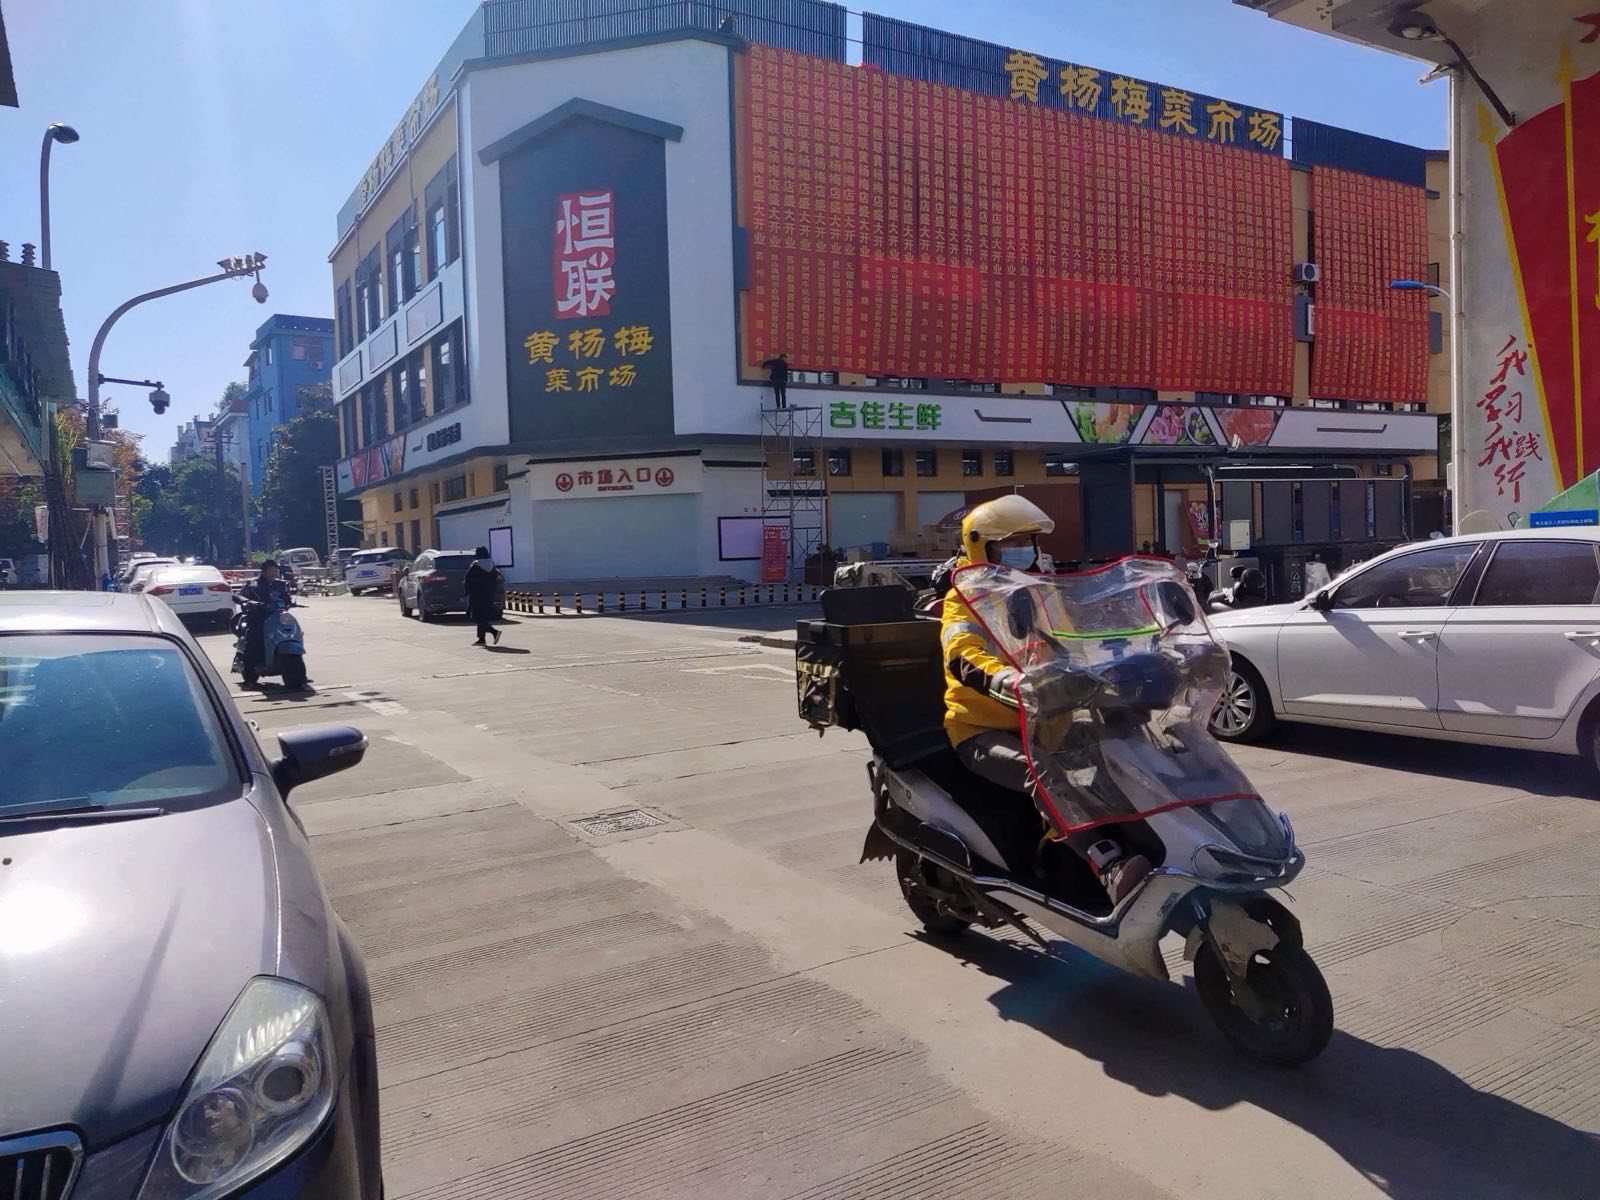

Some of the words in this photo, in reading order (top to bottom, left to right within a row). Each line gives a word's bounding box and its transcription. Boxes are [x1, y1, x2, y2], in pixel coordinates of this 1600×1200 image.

[1004, 50, 1283, 150] 黄杨梅菜市场
[556, 192, 615, 316] 恒联
[524, 325, 655, 365] 黄杨梅
[544, 365, 638, 393] 菜市场
[829, 400, 942, 430] 吉佳生鲜
[577, 467, 651, 485] 市场入口
